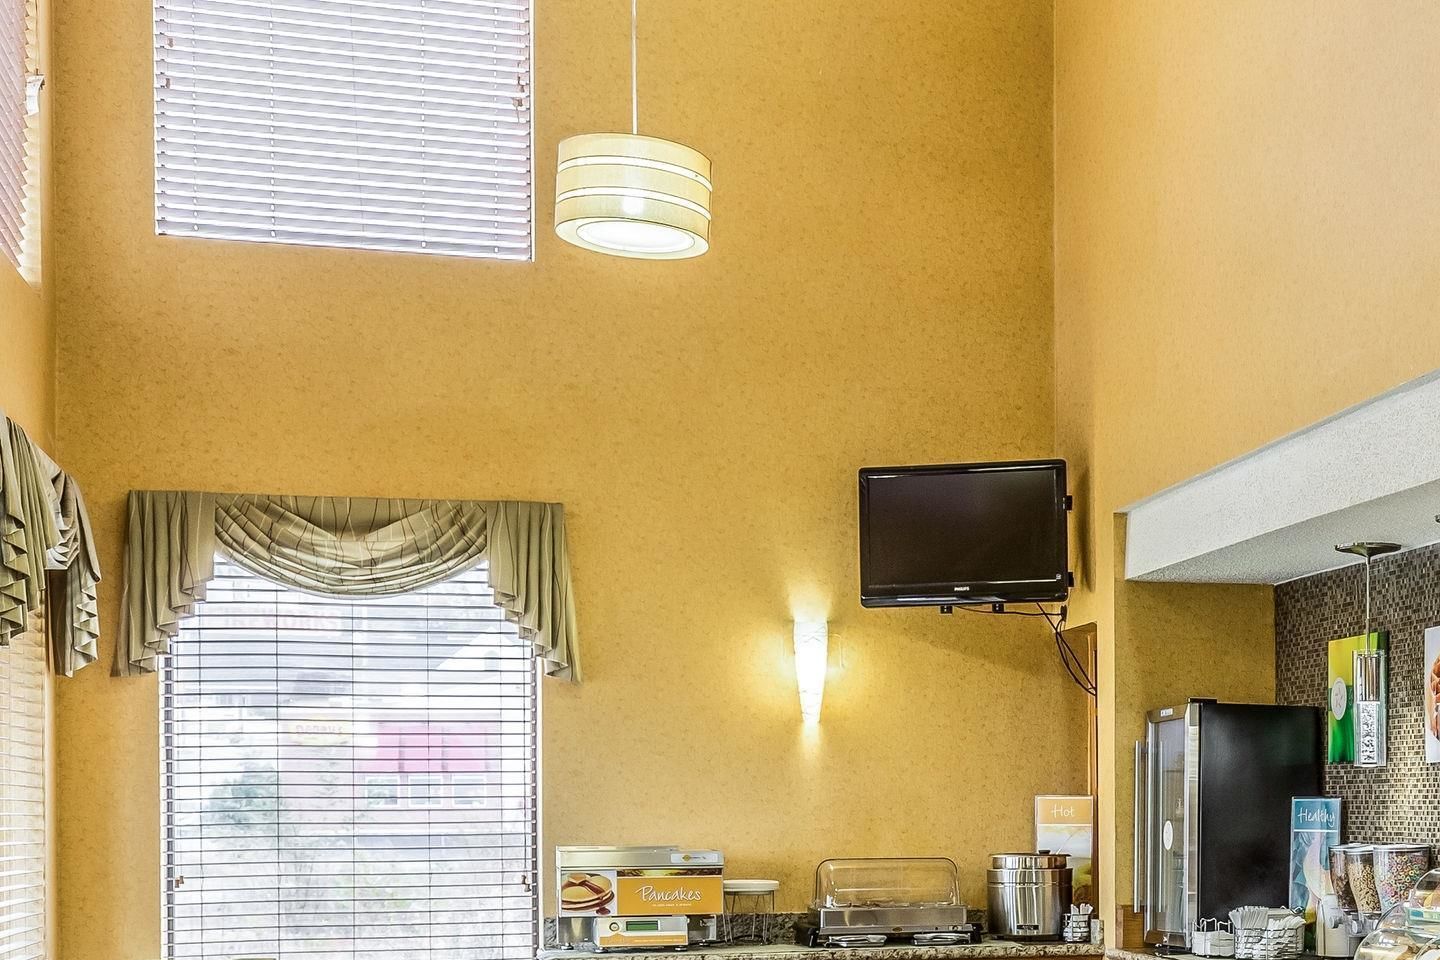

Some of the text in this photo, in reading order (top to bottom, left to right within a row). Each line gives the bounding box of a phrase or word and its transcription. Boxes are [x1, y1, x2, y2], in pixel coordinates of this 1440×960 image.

[1050, 803, 1076, 819] Hot
[1297, 806, 1336, 828] Healthy
[634, 885, 702, 901] Pancakes
